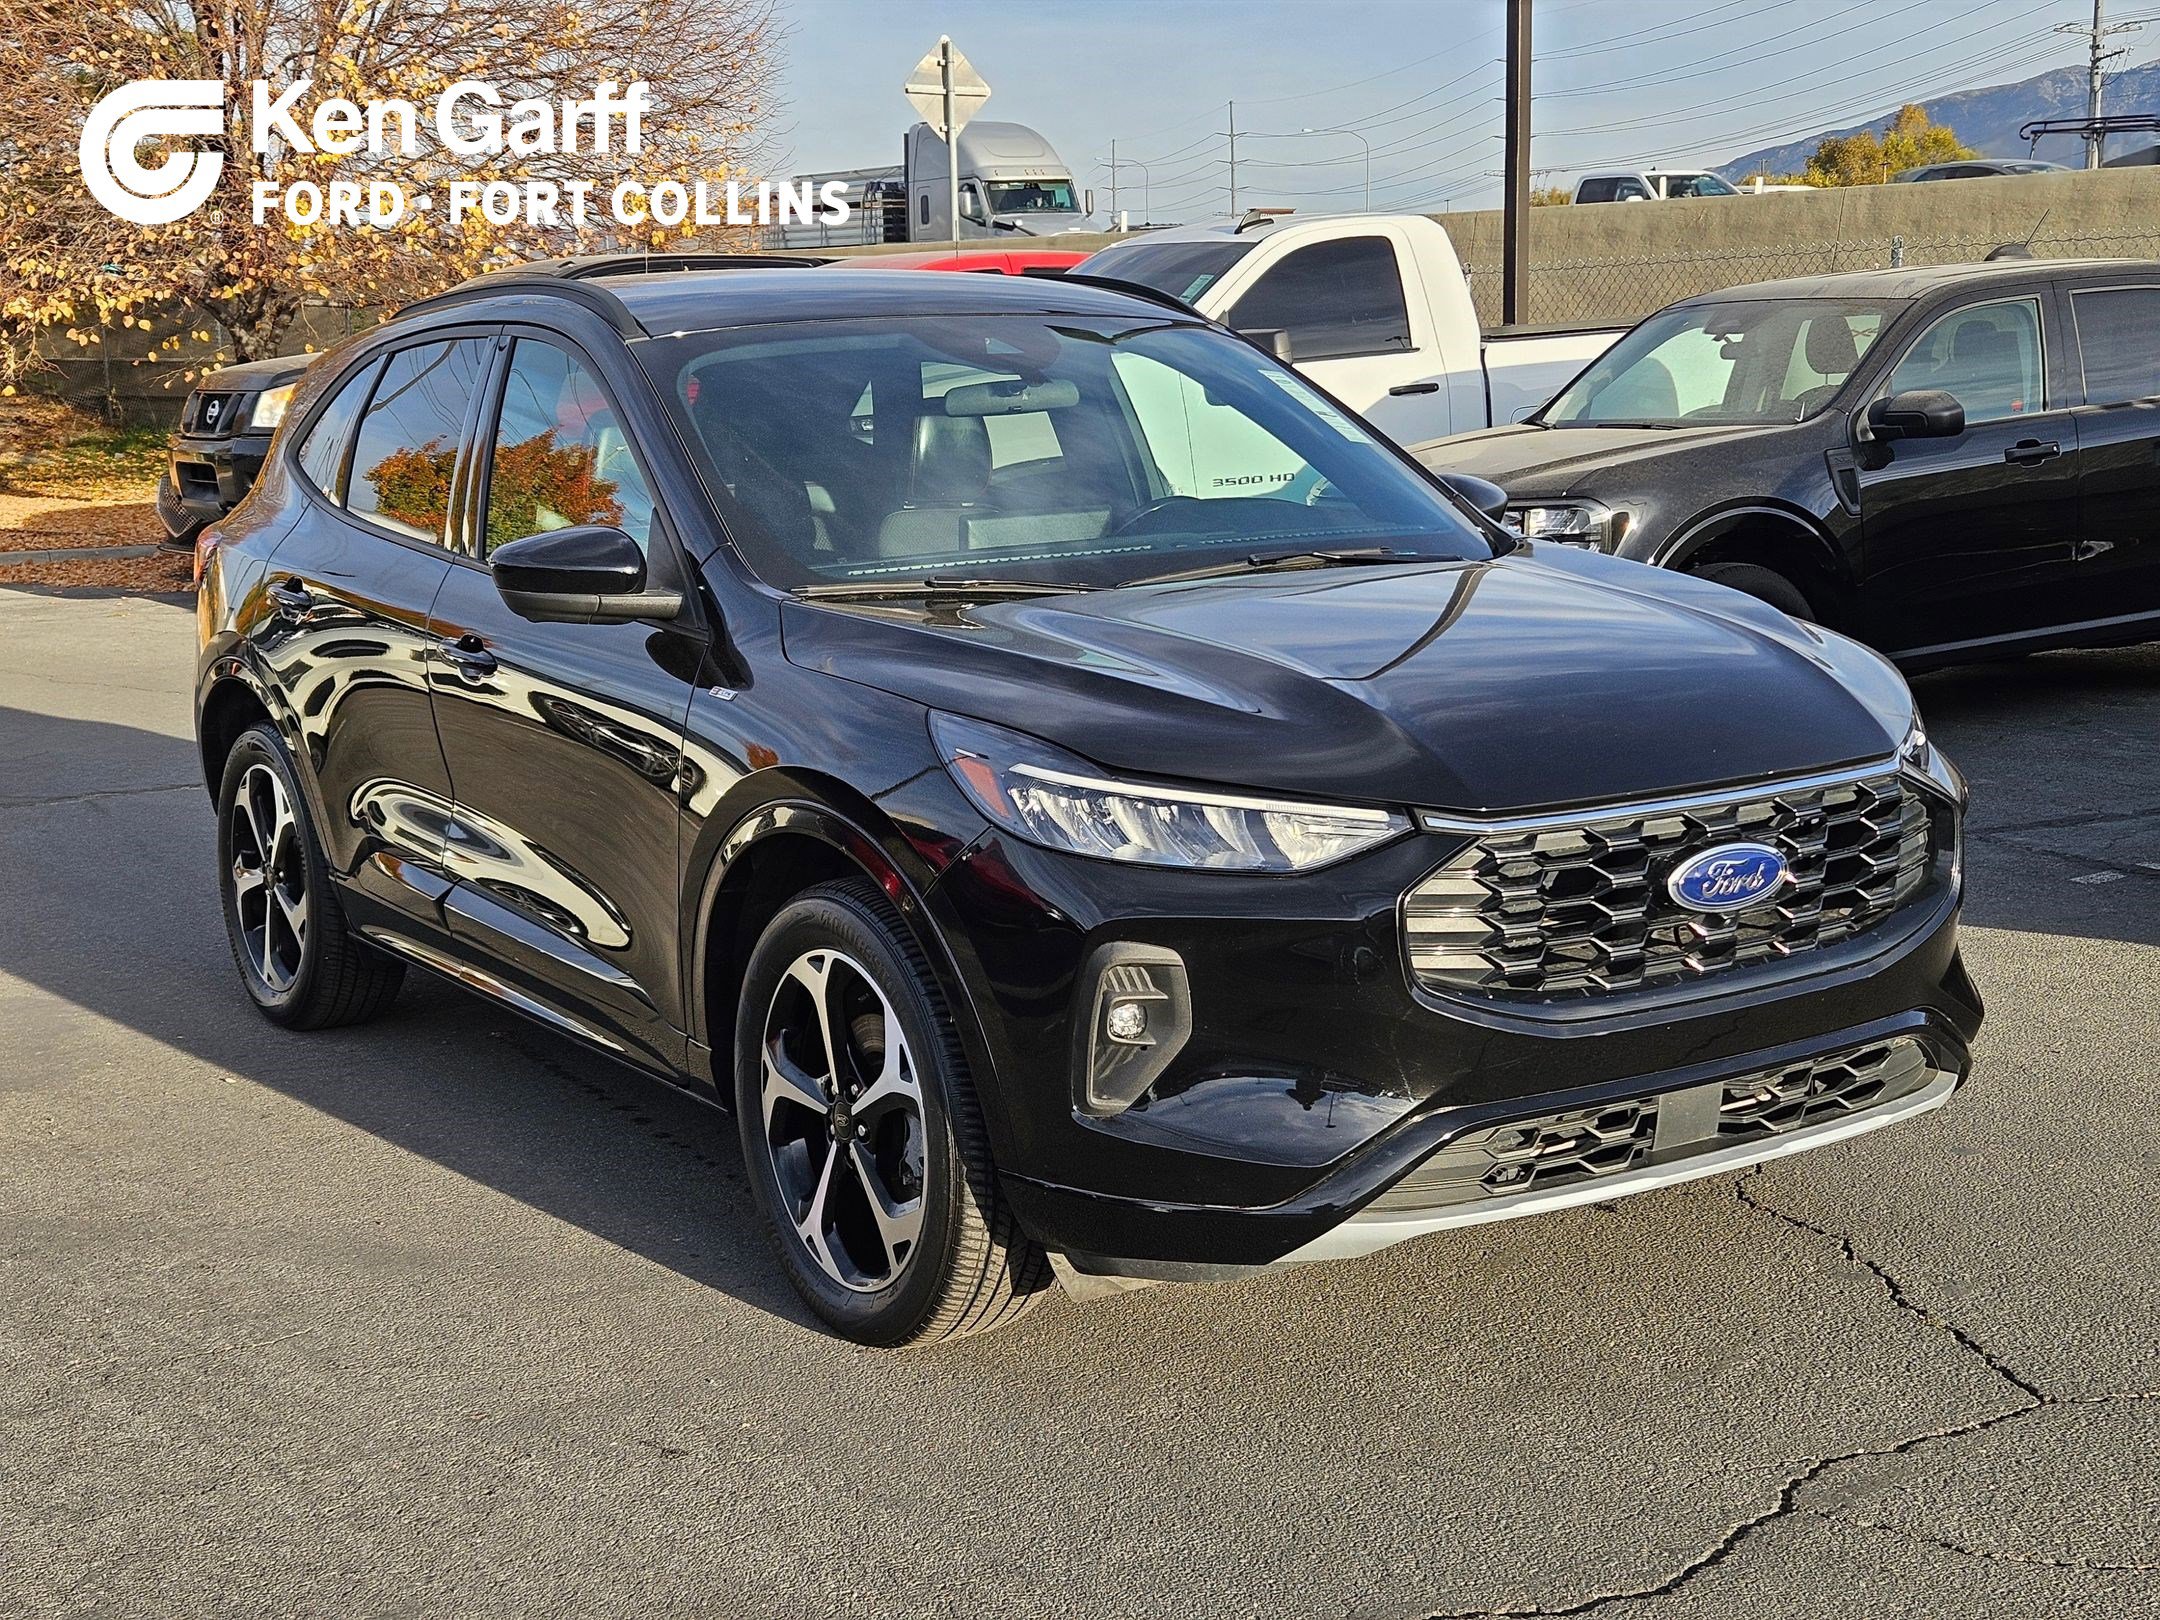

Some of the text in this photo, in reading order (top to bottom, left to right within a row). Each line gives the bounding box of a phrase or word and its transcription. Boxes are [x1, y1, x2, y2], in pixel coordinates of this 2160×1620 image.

[1212, 472, 1295, 488] 3500 HD
[1702, 857, 1766, 898] Ford
